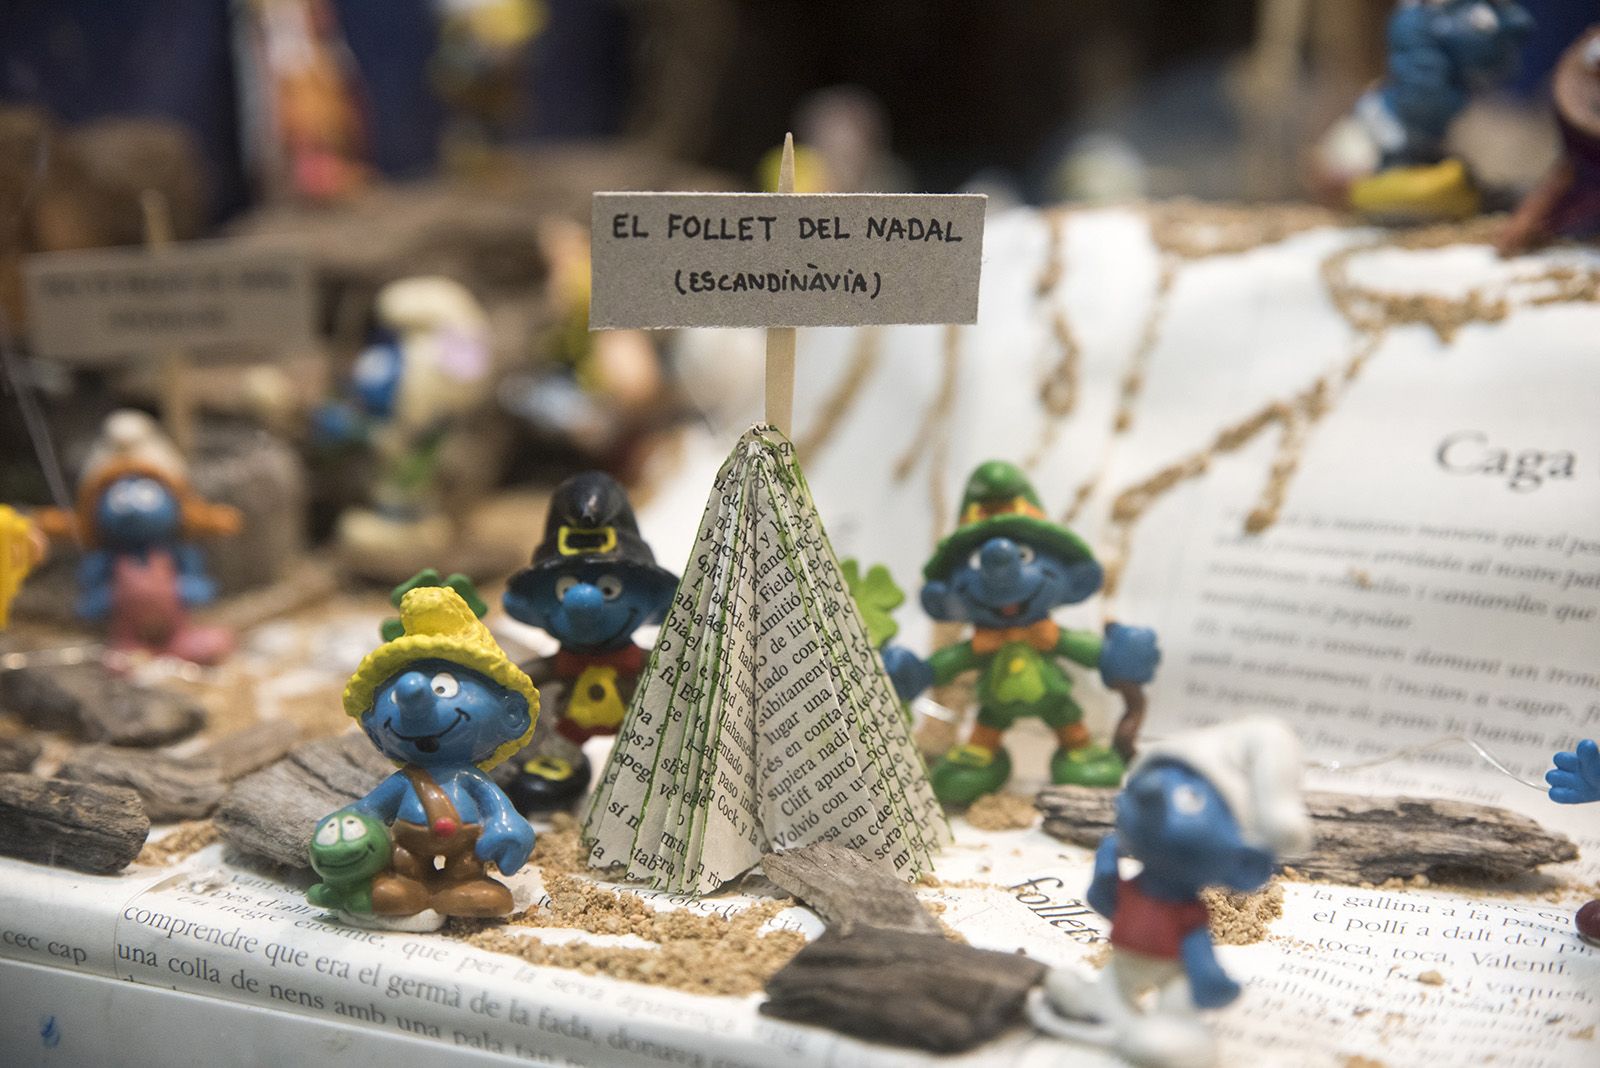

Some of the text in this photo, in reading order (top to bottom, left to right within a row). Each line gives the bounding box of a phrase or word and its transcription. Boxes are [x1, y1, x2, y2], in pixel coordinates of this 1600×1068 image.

[612, 213, 963, 243] EL FOLLET DEL NADAL
[1436, 429, 1577, 494] Caga
[759, 566, 796, 605] Field
[1555, 602, 1597, 625] que
[770, 635, 787, 655] de
[763, 687, 833, 747] lugar una
[785, 740, 803, 759] en
[767, 758, 817, 802] supiera
[717, 794, 740, 827] Cock
[780, 785, 813, 817] Cliff
[822, 791, 849, 815] con
[841, 804, 869, 829] con
[1313, 889, 1333, 901] la
[1342, 896, 1430, 915] gallina
[1441, 907, 1456, 917] a
[1470, 910, 1489, 921] la
[1313, 910, 1337, 924] el
[1345, 917, 1409, 936] pollí
[1416, 926, 1430, 937] a
[1442, 926, 1492, 941] dalt
[1504, 933, 1547, 948] del
[2, 929, 88, 966] cec cap
[123, 905, 259, 955] comprendre
[265, 940, 309, 968] que
[315, 955, 351, 980] era
[358, 963, 382, 988] el
[469, 990, 501, 1020] de
[400, 940, 450, 963] que
[117, 943, 159, 968] una
[167, 955, 221, 984] colla
[230, 968, 260, 994] de
[269, 982, 325, 1011] nens
[333, 999, 387, 1026] amb
[394, 1014, 441, 1041] una
